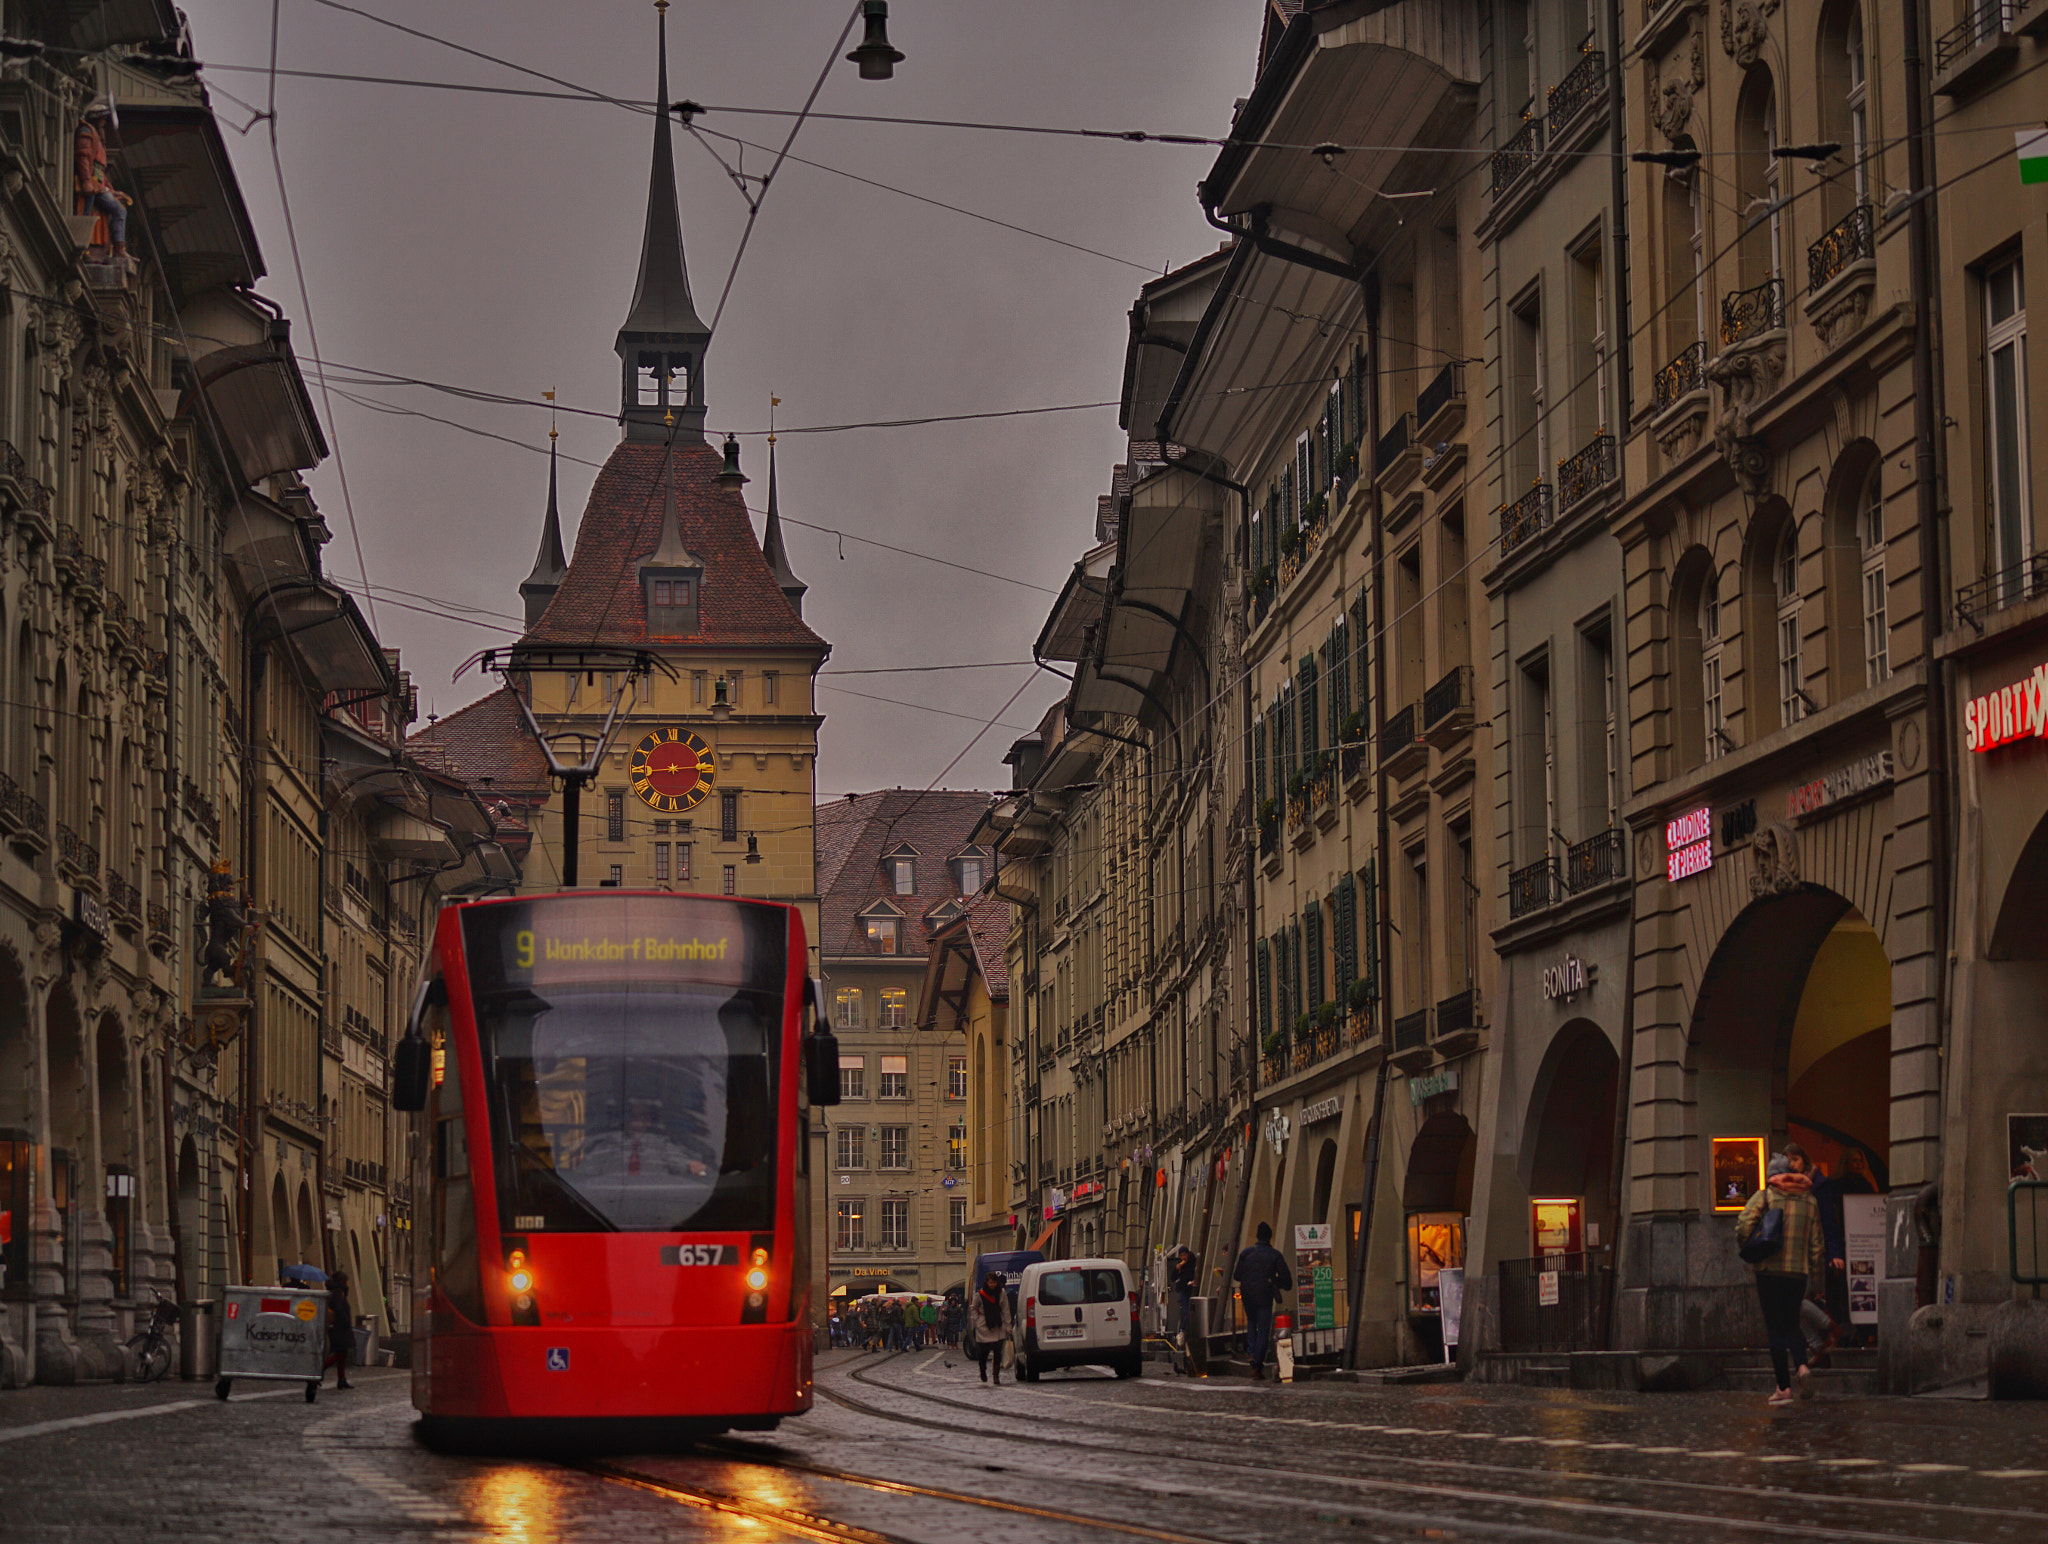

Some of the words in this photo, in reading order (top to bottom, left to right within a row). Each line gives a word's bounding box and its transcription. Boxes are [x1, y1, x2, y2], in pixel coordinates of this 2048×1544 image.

[649, 732, 662, 746] XI
[667, 728, 678, 741] XII
[686, 733, 695, 745] I
[636, 746, 650, 757] X
[697, 746, 709, 757] II
[668, 797, 678, 810] VI
[687, 794, 697, 806] V
[1667, 808, 1710, 850] CLAUDINE
[516, 930, 534, 968] 9
[545, 937, 641, 961] Wankdorf
[645, 937, 728, 960] Bahnhof
[678, 1243, 723, 1267] 657
[854, 1268, 867, 1276] Da
[868, 1267, 890, 1276] Vinci
[1314, 1267, 1332, 1281] 250
[246, 1322, 306, 1343] Kaiserhaus
